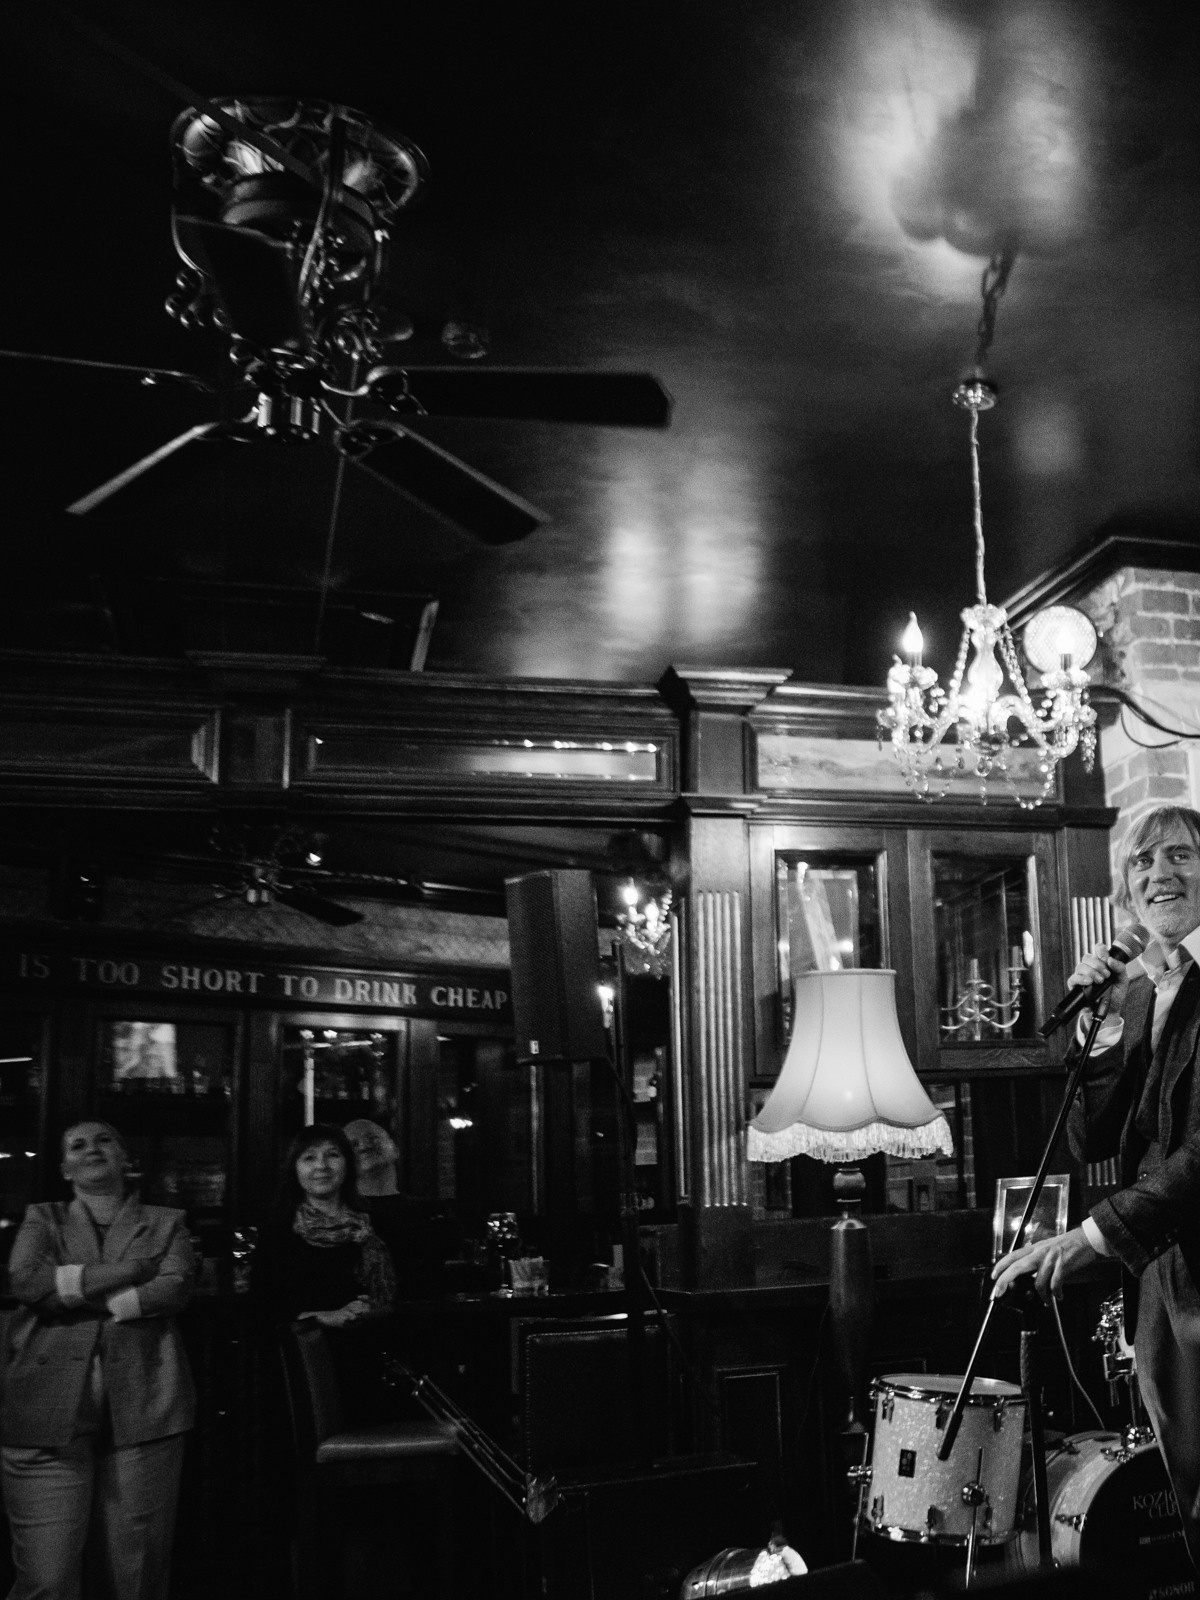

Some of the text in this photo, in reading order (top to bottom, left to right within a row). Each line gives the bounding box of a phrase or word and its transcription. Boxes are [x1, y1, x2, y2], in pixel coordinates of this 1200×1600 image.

[20, 952, 508, 1010] IS TOO SHORT TO DRINK CHEAP
[1148, 1503, 1176, 1518] CLU
